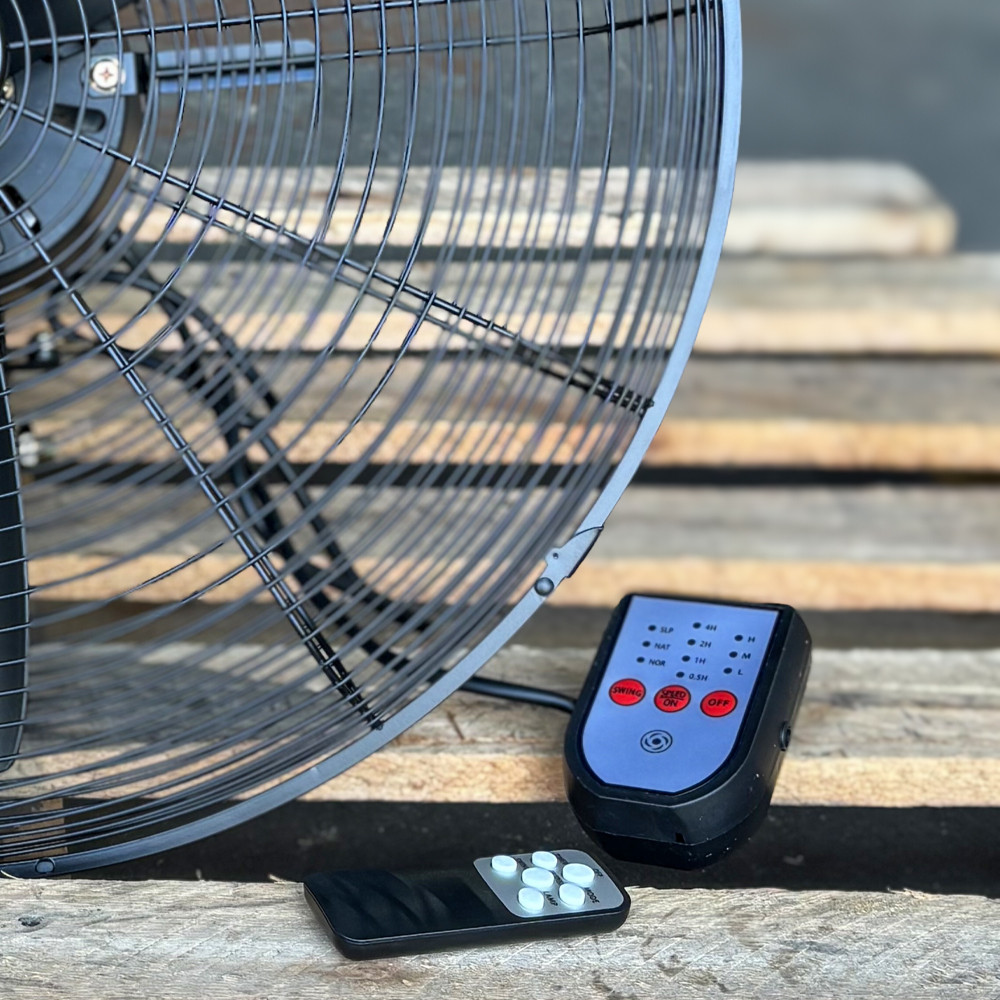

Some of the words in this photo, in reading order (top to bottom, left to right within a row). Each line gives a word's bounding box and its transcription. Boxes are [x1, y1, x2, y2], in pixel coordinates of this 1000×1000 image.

[660, 626, 674, 634] SLP
[654, 643, 671, 651] NAT
[649, 659, 666, 667] NOR
[688, 673, 708, 681] 0.5H
[612, 686, 642, 697] SWING
[663, 699, 678, 707] ON
[708, 698, 730, 707] OFF
